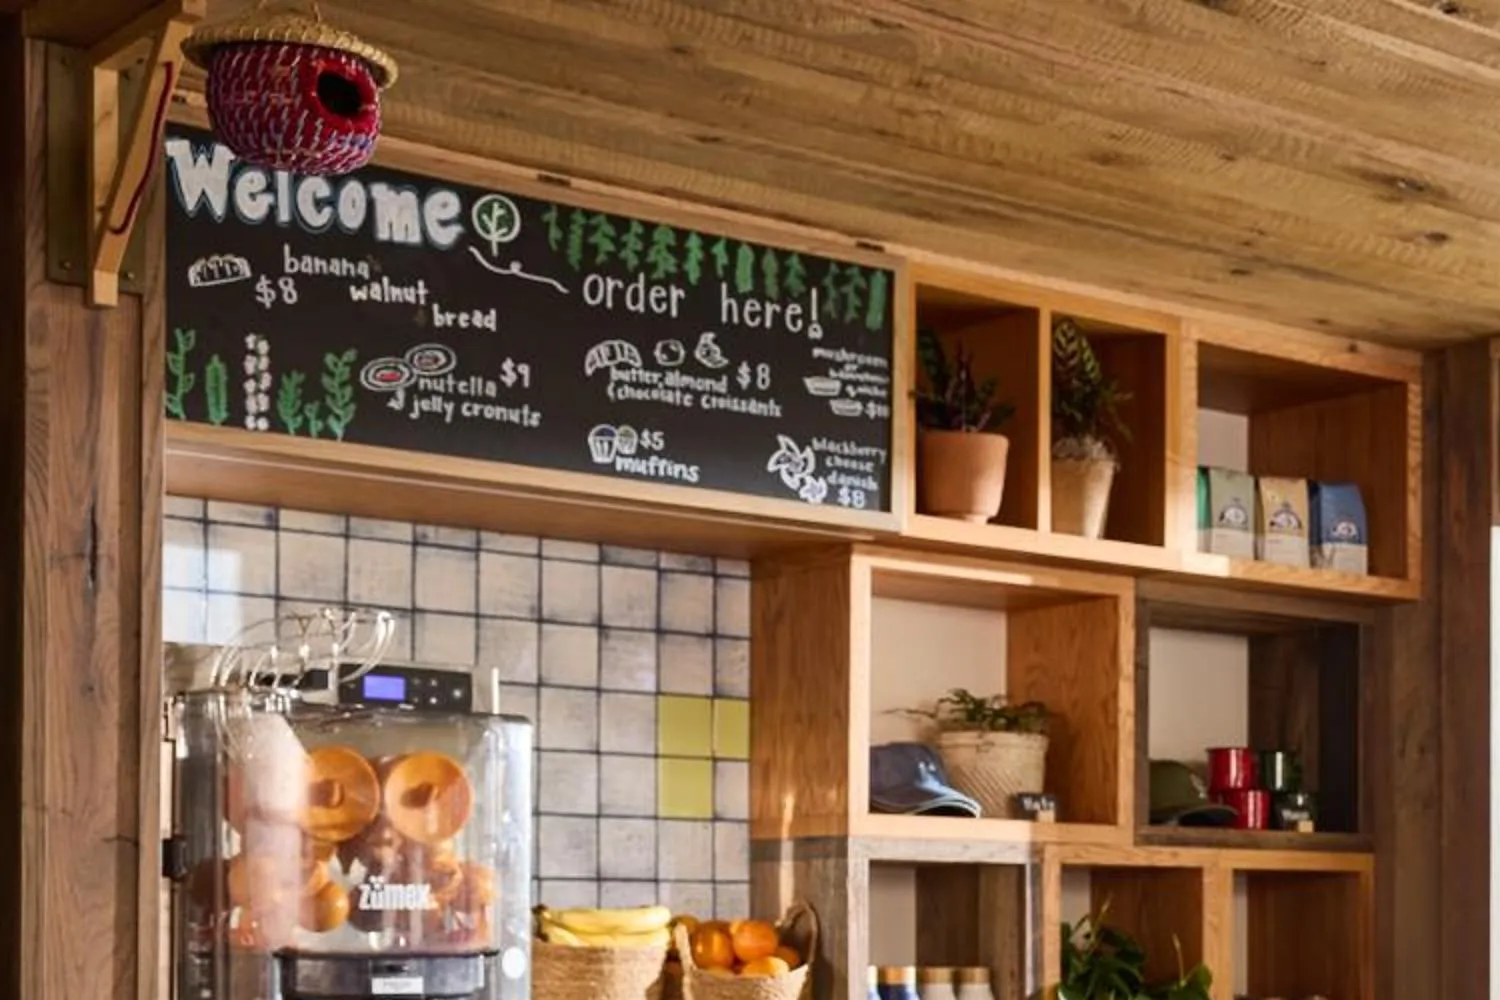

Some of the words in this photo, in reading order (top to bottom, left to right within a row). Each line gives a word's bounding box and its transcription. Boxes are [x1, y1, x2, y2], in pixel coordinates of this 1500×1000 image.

[165, 138, 465, 247] Welcome
[283, 244, 371, 279] banana
[255, 275, 299, 309] $8
[349, 276, 429, 305] walnut
[432, 303, 498, 332] bread
[720, 281, 824, 340] here!
[418, 374, 499, 399] nutella
[500, 356, 531, 389] $9
[735, 359, 772, 391] $8
[409, 396, 455, 424] jelly
[460, 397, 542, 428] cronuts
[639, 430, 666, 452] $5
[615, 454, 701, 483] muffins
[837, 485, 866, 510] $8
